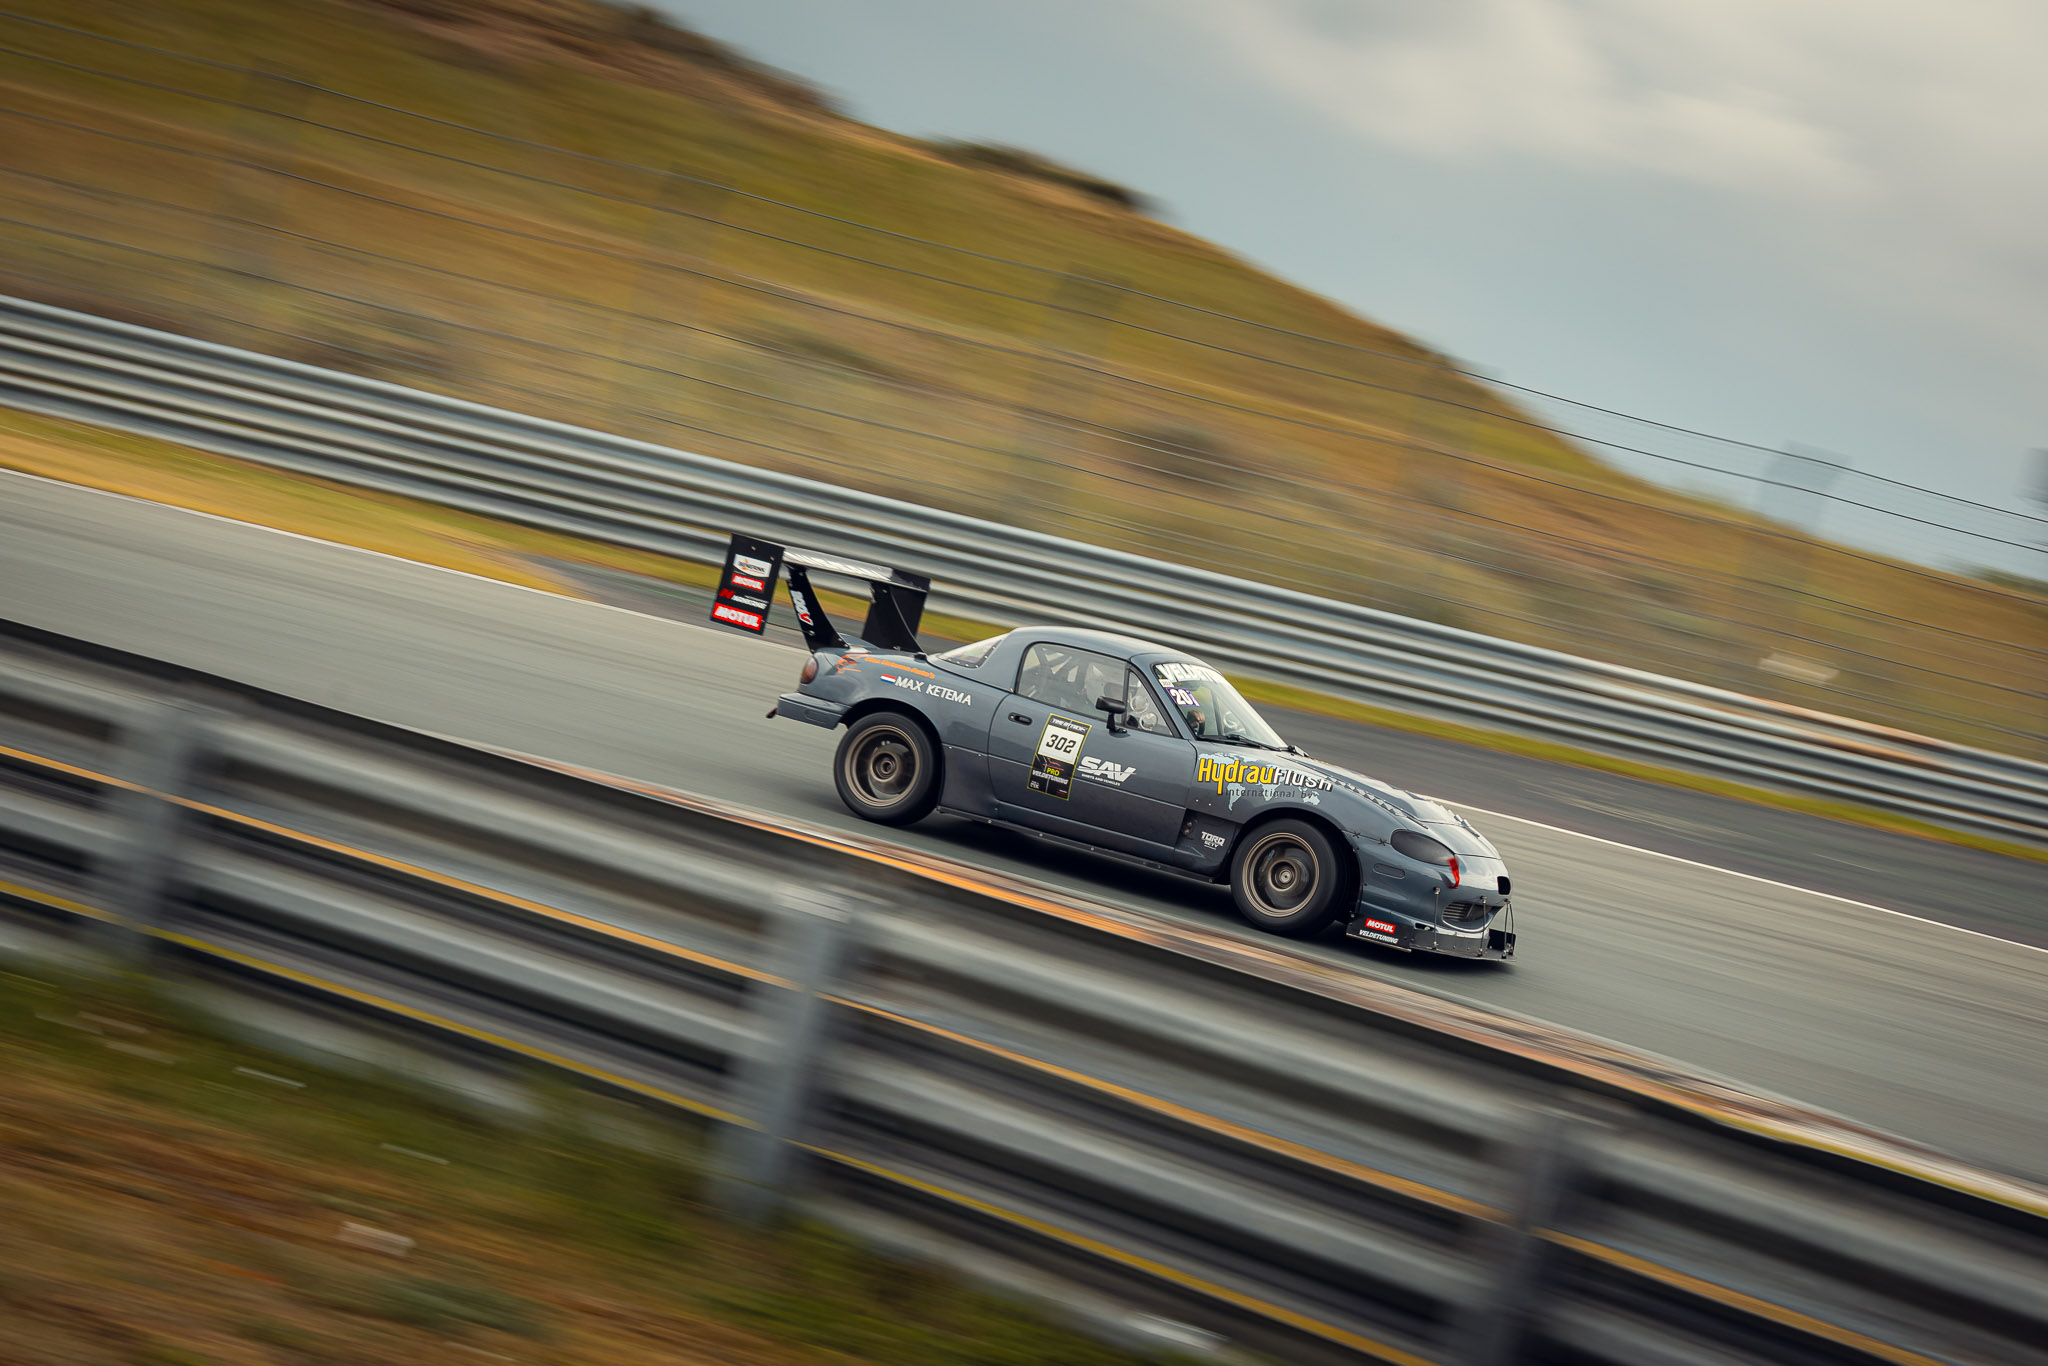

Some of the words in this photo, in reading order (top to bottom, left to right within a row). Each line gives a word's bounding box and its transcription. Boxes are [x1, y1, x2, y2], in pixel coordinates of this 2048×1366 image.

[714, 605, 760, 628] MOTUL
[895, 675, 925, 693] MAX
[926, 683, 972, 707] KETEMA
[1045, 734, 1077, 754] 302
[1046, 767, 1060, 777] PRO
[1077, 756, 1137, 782] SAV
[1197, 758, 1334, 795] HydrauFlush
[1201, 831, 1226, 847] TORQ
[1366, 919, 1394, 933] MOTUL
[1359, 929, 1399, 944] VELDETUNING
